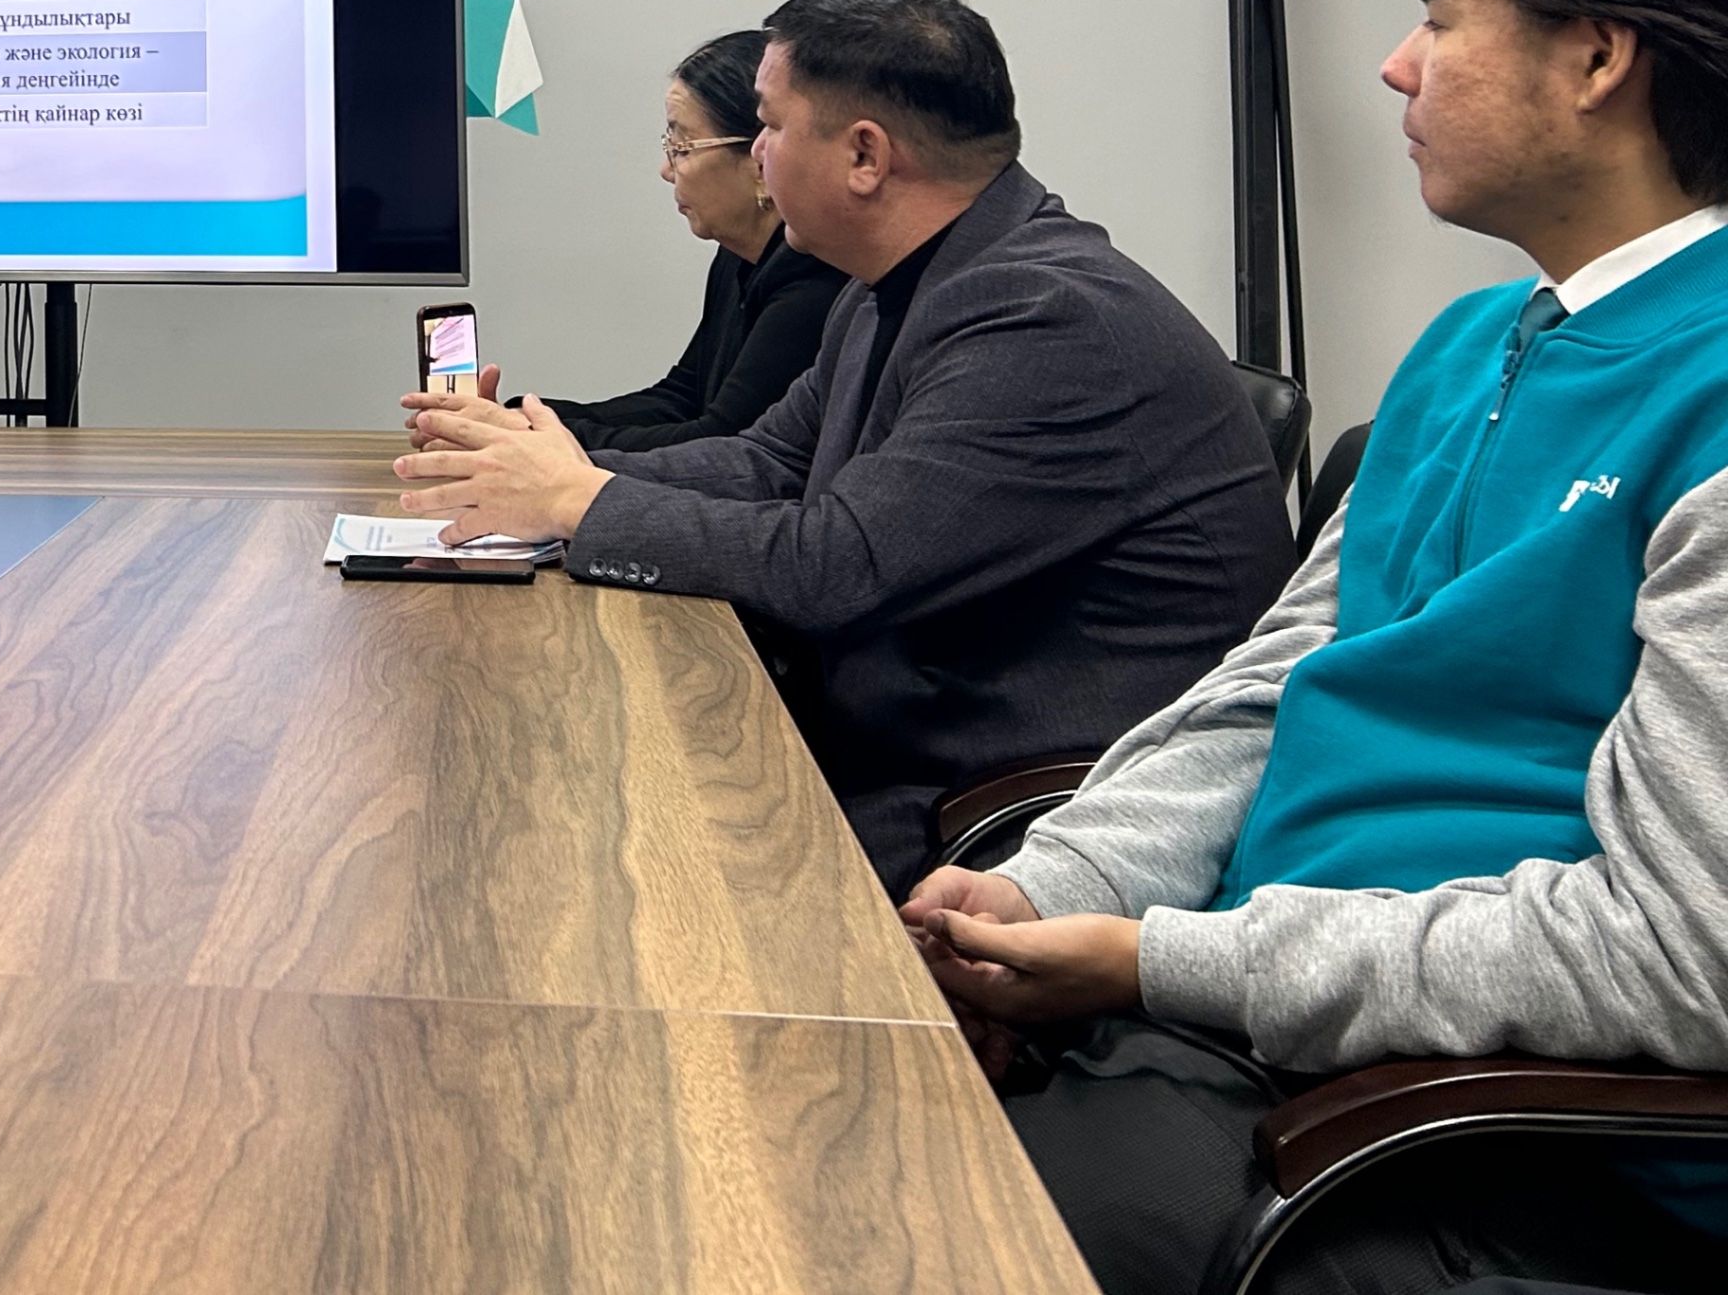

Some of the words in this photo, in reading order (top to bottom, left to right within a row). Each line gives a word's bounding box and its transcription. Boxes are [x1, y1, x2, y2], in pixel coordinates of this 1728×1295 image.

[5, 46, 52, 61] және
[56, 46, 142, 60] экология
[16, 69, 120, 89] деңгейінде
[35, 105, 101, 125] қайнар
[105, 103, 143, 121] көзі
